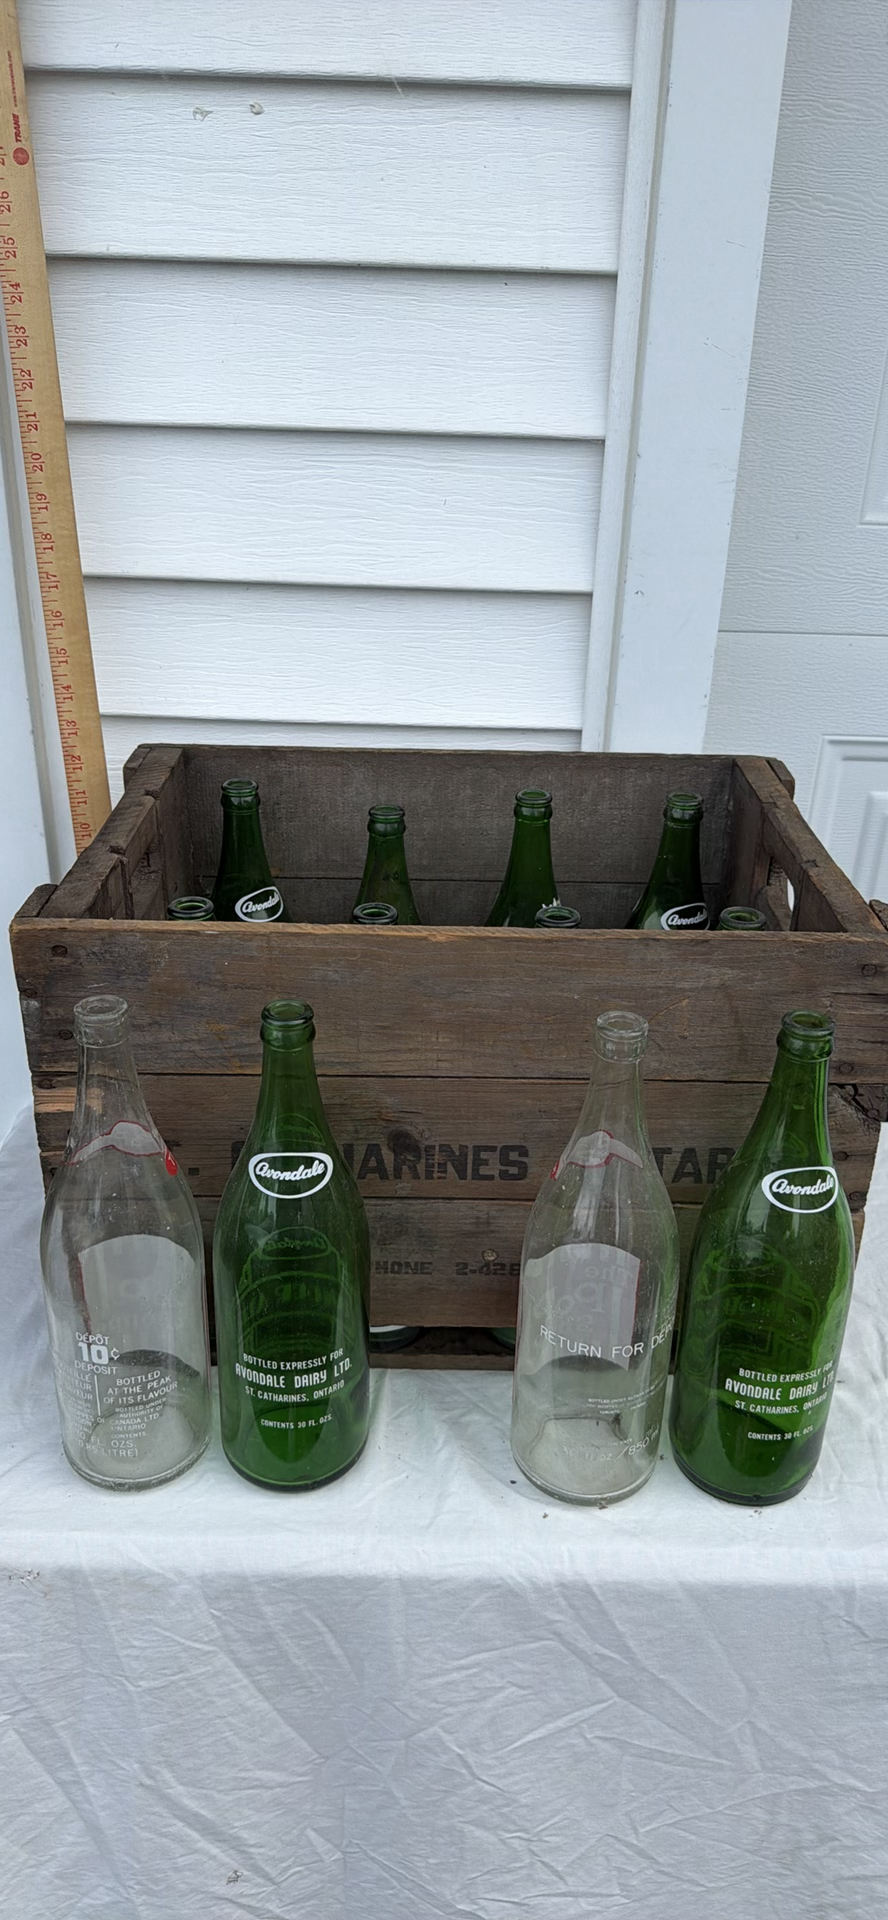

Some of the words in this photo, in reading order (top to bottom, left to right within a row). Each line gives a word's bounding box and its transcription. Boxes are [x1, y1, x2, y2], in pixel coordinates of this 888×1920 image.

[12, 113, 22, 143] TRANE
[3, 237, 17, 259] 25
[9, 282, 22, 303] 24
[15, 326, 28, 347] 23
[20, 369, 33, 390] 22
[25, 412, 38, 432] 21
[31, 452, 43, 472] 20
[36, 493, 49, 511] 19
[41, 533, 54, 551] 18
[46, 573, 59, 590] 17
[51, 610, 63, 627] 16
[56, 648, 68, 665] 15
[61, 684, 73, 701] 14
[66, 720, 78, 736] 13
[71, 755, 83, 771] 12
[76, 789, 87, 805] 11
[80, 823, 92, 839] 10
[254, 1160, 326, 1181] Avondale
[771, 1176, 835, 1196] Avondale
[375, 1261, 433, 1275] HONE
[75, 1332, 110, 1345] DÉPÔT
[540, 1324, 602, 1358] RETURN
[611, 1342, 644, 1358] FOR
[74, 1360, 118, 1375] DEPOSIT
[243, 1353, 277, 1369] BOTTLED
[280, 1356, 327, 1370] EXPRESSLY
[330, 1348, 343, 1361] FOR
[116, 1370, 161, 1386] BOTTLED
[235, 1363, 286, 1388] AVONDALE
[294, 1370, 327, 1388] DAIRY
[334, 1357, 352, 1377] LTD.
[738, 1368, 777, 1383] BOTTLED
[780, 1367, 821, 1382] EXPRESSLY
[103, 1396, 116, 1405] OF
[118, 1395, 134, 1404] ITS
[137, 1381, 178, 1402] FLAVOUR
[123, 1384, 142, 1394] THE
[147, 1376, 171, 1390] PEAK
[245, 1386, 255, 1396] ST.
[313, 1379, 344, 1399] ONTARIO
[725, 1378, 782, 1401] AVONDALE
[789, 1382, 818, 1400] DAIRY
[735, 1400, 746, 1411] ST.
[803, 1392, 827, 1411] ONTARIO
[261, 1419, 294, 1428] CONTENTS
[748, 1431, 781, 1441] CONTENTS
[784, 1432, 792, 1440] 30
